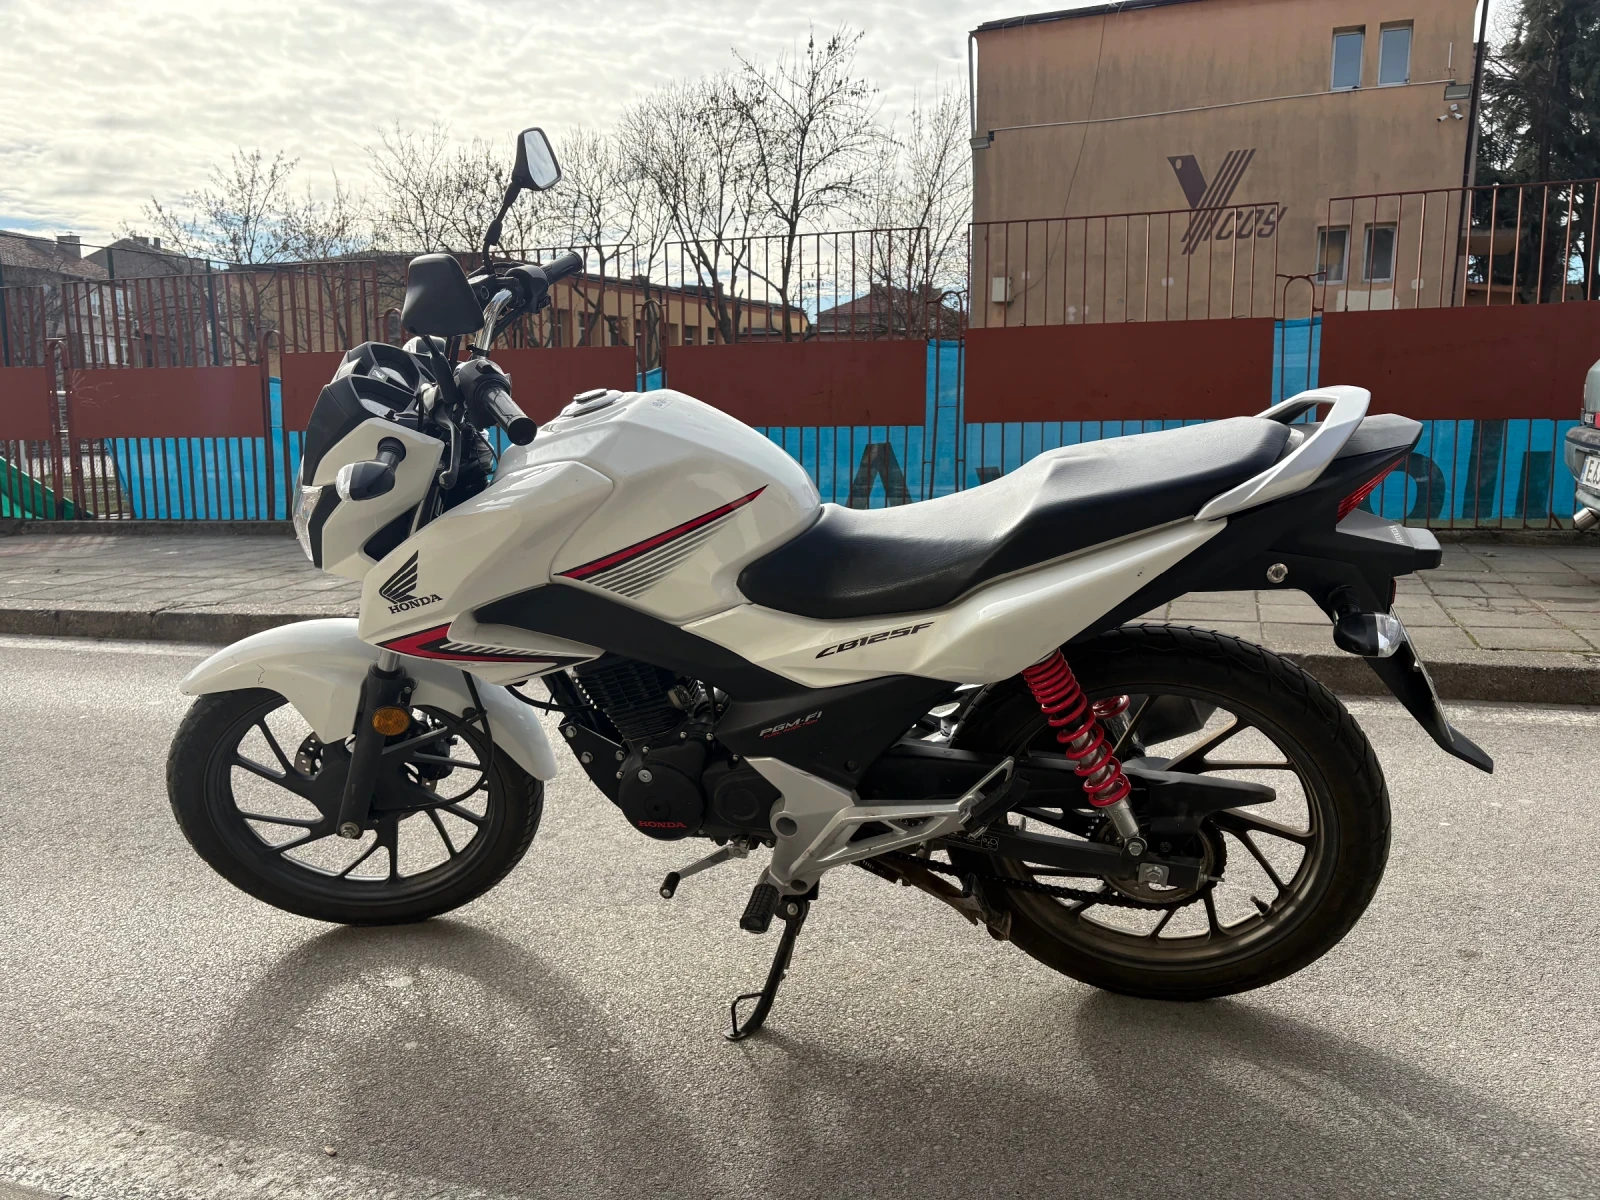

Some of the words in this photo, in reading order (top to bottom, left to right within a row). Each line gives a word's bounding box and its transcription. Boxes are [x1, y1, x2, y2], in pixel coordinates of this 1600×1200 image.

[387, 593, 443, 614] HONDA
[815, 621, 935, 659] CB125F
[759, 710, 823, 737] PGM-FI
[637, 820, 687, 829] HONDA
